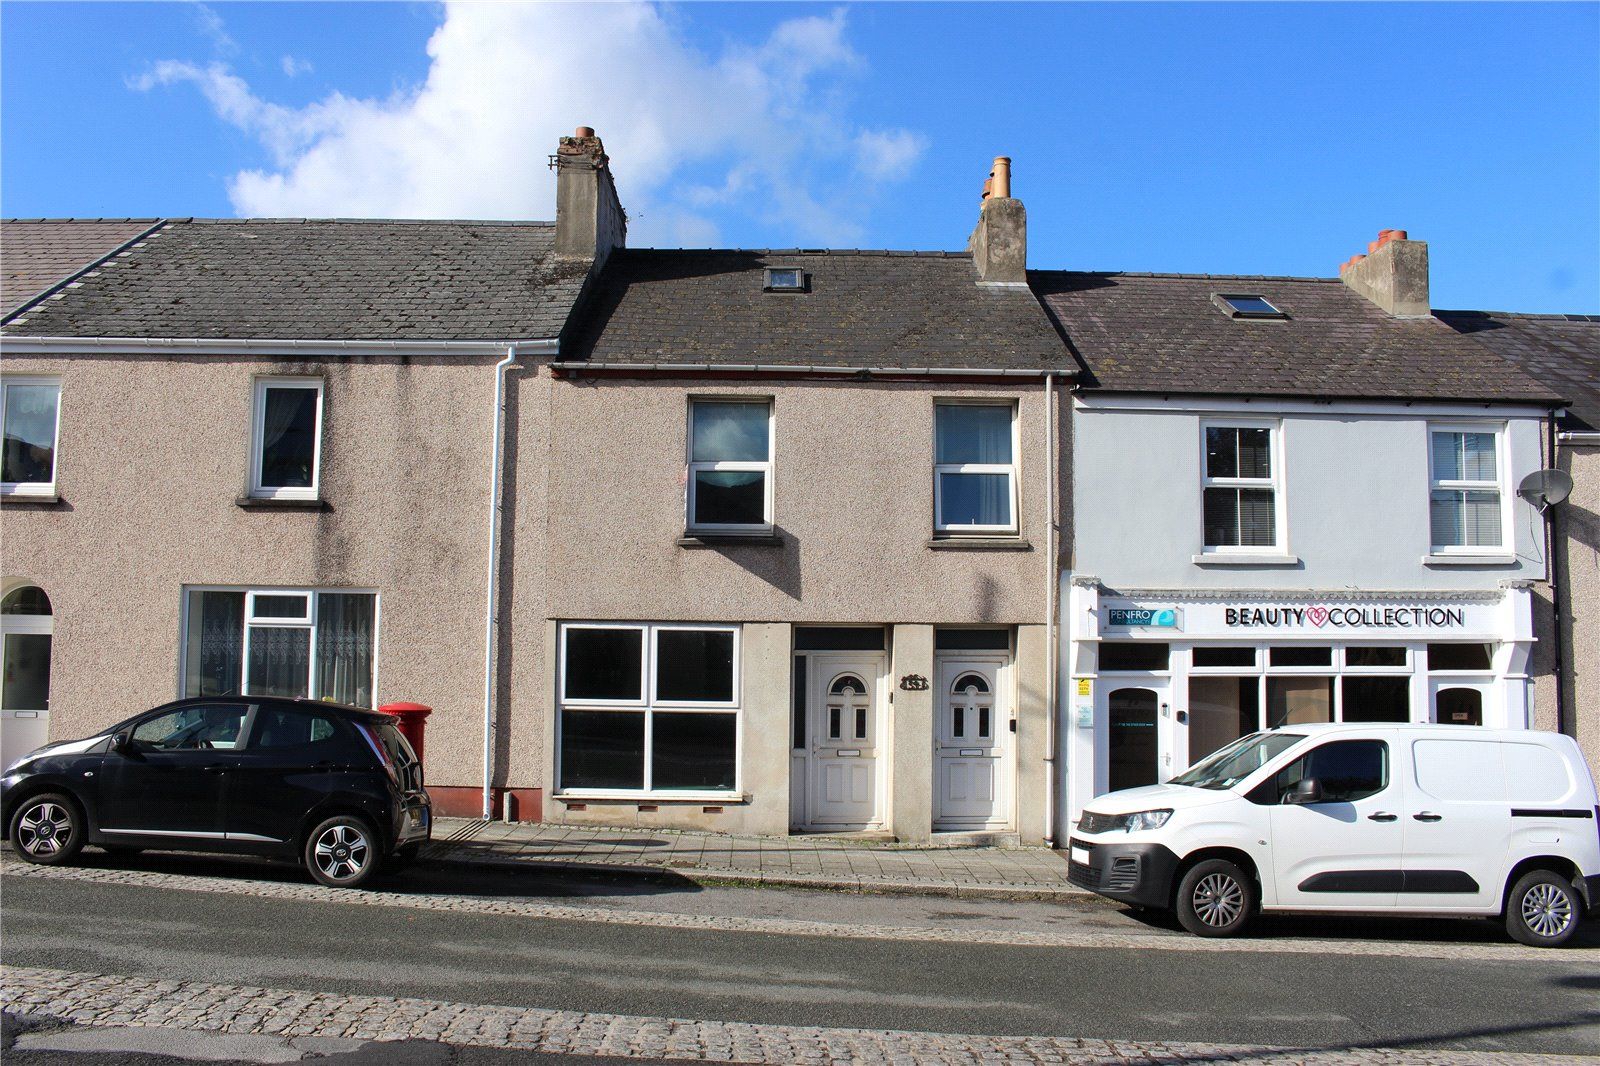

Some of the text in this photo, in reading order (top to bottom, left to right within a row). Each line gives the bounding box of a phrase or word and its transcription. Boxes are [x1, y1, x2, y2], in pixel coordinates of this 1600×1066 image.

[1110, 610, 1151, 620] PENFRO
[1225, 607, 1462, 625] BEAUTY COLLECTION
